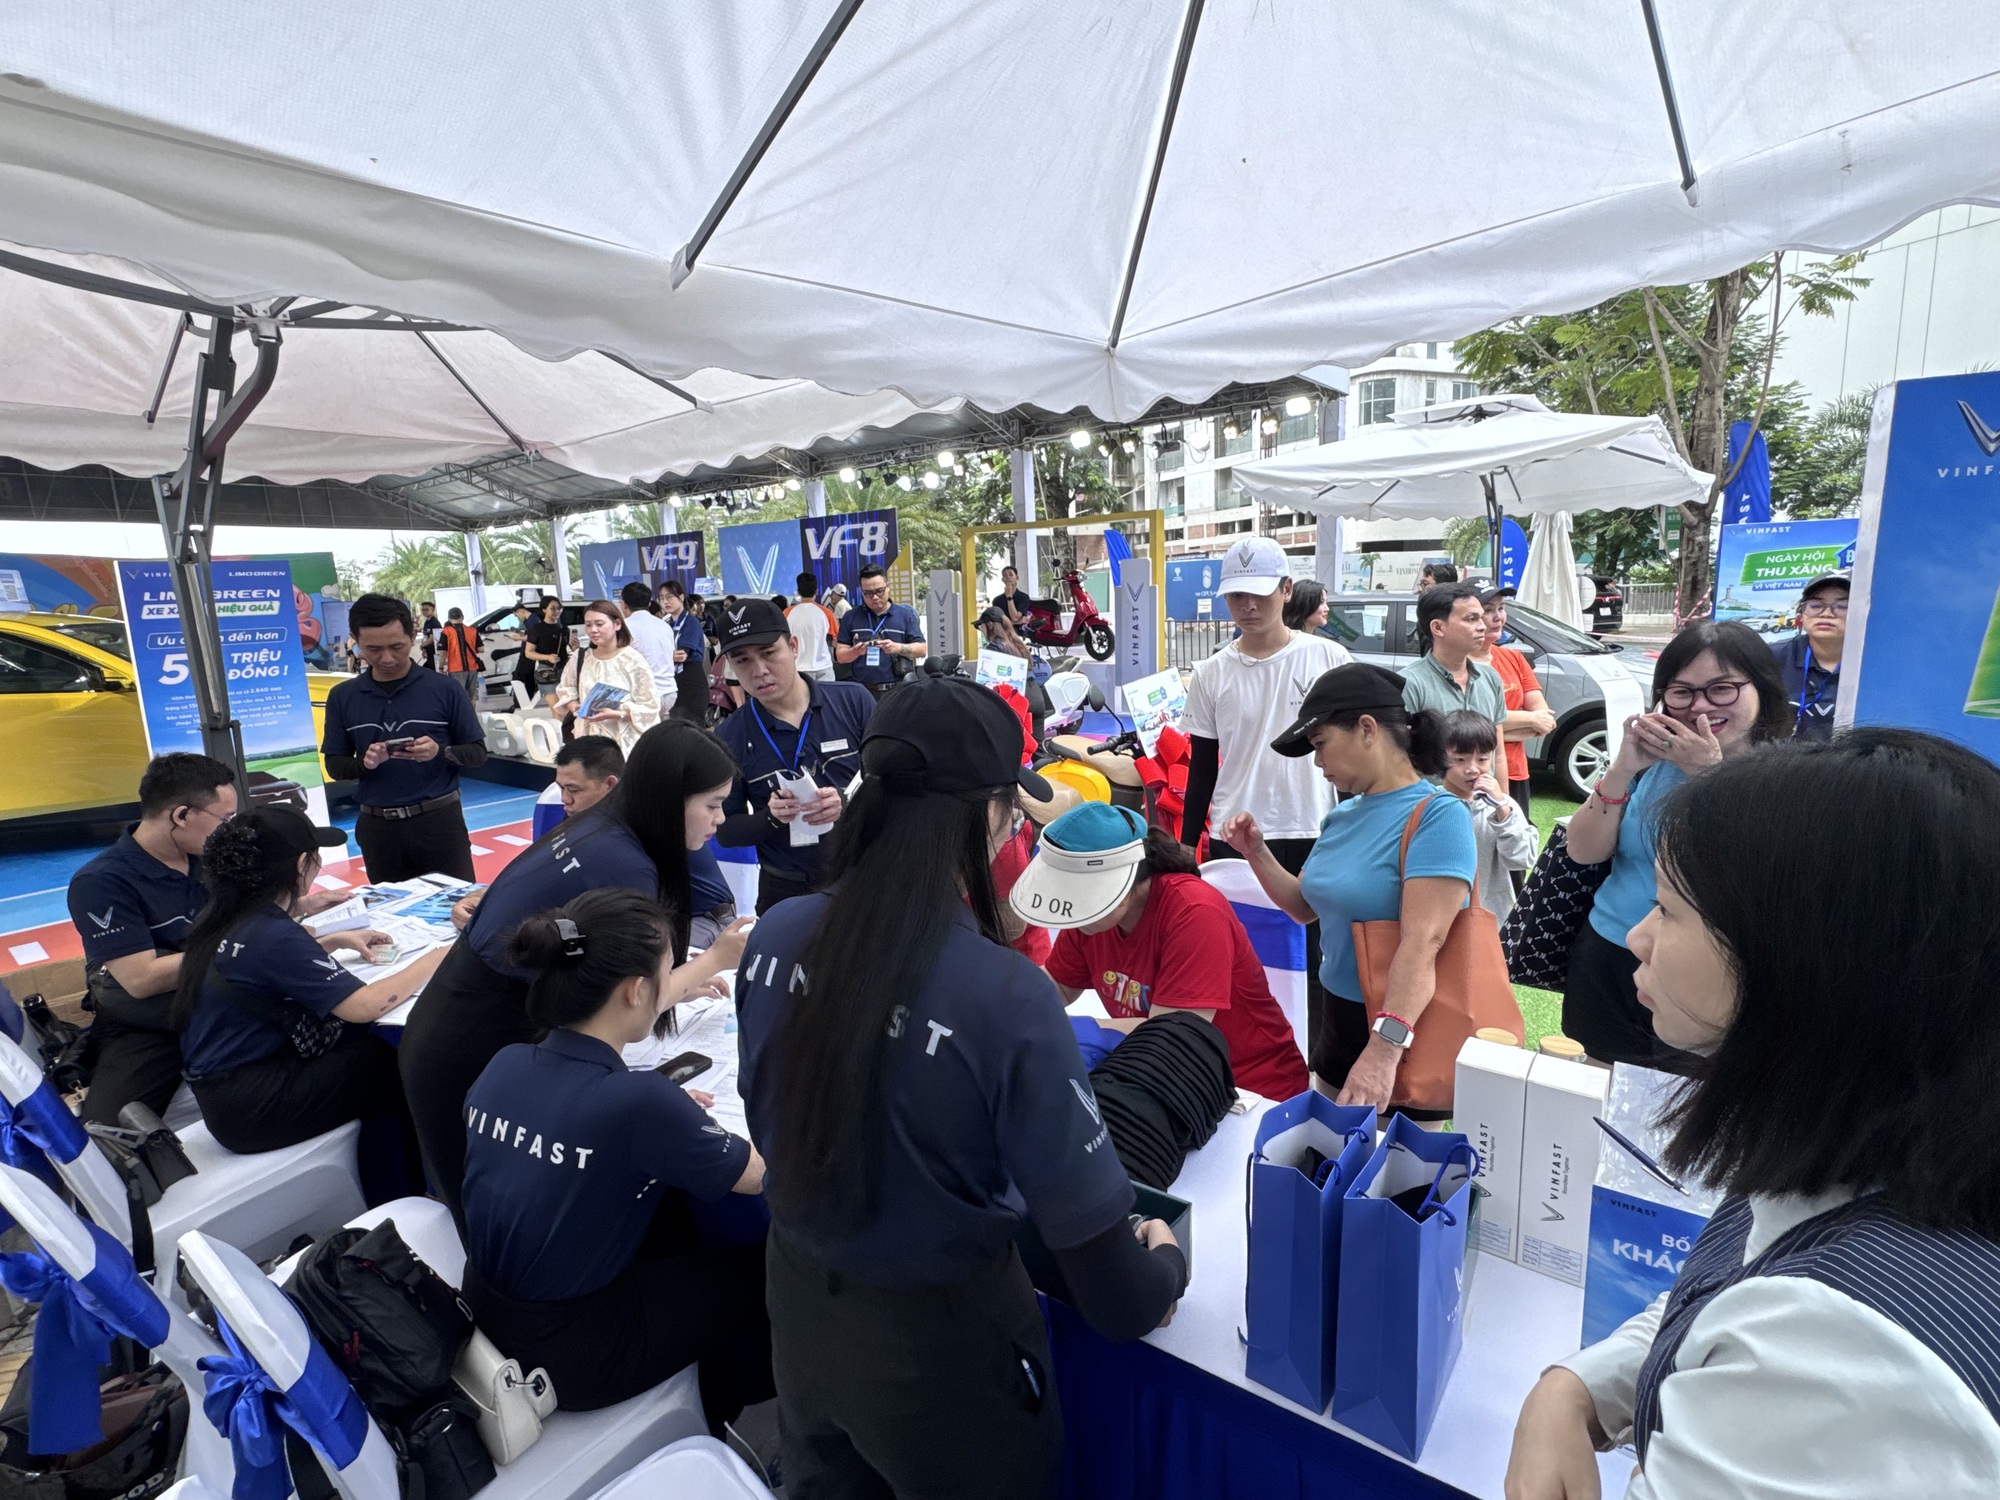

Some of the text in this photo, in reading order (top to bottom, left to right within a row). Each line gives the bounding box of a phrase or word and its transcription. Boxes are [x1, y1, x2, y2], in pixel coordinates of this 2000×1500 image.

[1937, 465, 2000, 478] VINF
[1746, 526, 1791, 534] VINFAST
[805, 521, 888, 560] VF8
[641, 541, 698, 571] VF9
[1766, 550, 1825, 564] NGÀY HỘI
[1503, 546, 1514, 588] FAST
[1756, 567, 1786, 577] THU
[146, 607, 163, 616] XE
[217, 604, 246, 614] HIỆU
[255, 631, 278, 640] hơn
[158, 648, 281, 685] 5 TRIỆU
[228, 664, 280, 680] ĐỒNG
[92, 926, 125, 938] VINFAST
[468, 1106, 594, 1169] VINFAST
[1478, 1123, 1489, 1178] VINFAST
[1550, 1144, 1562, 1200] VINFAST
[1610, 1199, 1658, 1217] VINFAST
[1662, 1234, 1690, 1252] BỐ
